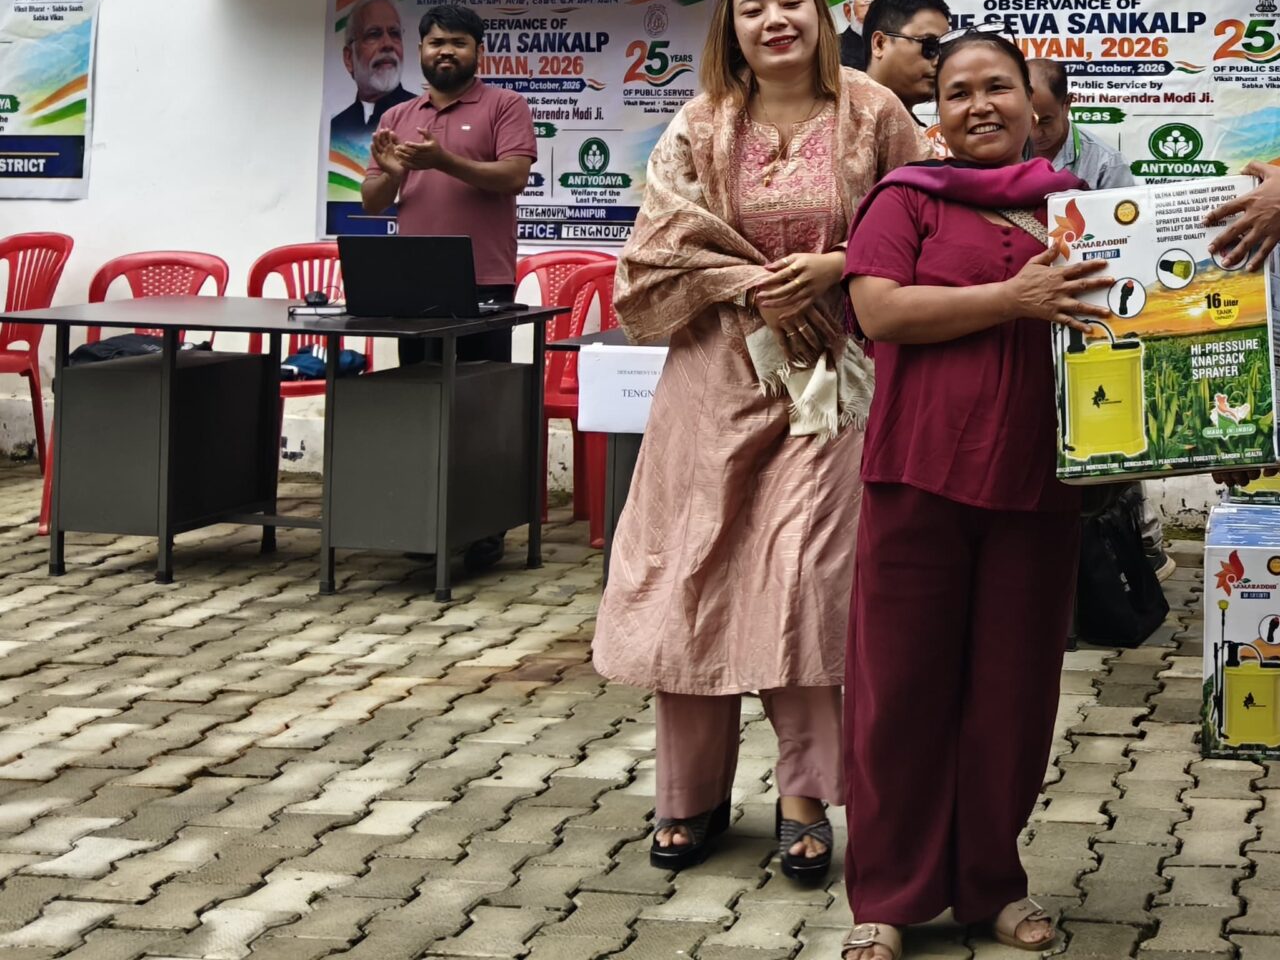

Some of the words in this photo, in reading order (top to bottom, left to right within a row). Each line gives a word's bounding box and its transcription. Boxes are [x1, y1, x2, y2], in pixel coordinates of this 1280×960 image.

[483, 18, 547, 30] SERVANCE
[550, 18, 568, 30] OF
[1067, 11, 1206, 34] SANKALP
[516, 31, 610, 53] SANKALP
[1213, 19, 1276, 61] 25
[1101, 36, 1168, 58] 2026
[538, 55, 584, 75] 2026
[623, 40, 670, 84] 25
[670, 54, 693, 63] YEARS
[1087, 63, 1135, 74] October,
[1137, 63, 1165, 73] 2026
[1213, 65, 1228, 73] OF
[1229, 65, 1266, 73] PUBLIC
[505, 81, 514, 90] to
[530, 81, 561, 92] October,
[562, 81, 581, 90] 2026
[1071, 80, 1104, 89] Public
[1107, 80, 1147, 89] Service
[1150, 80, 1163, 90] by
[623, 89, 632, 97] OF
[634, 89, 662, 97] PUBLIC
[663, 89, 695, 97] SERVICE
[1070, 92, 1095, 103] Shri
[1099, 92, 1160, 103] Narendra
[1164, 92, 1195, 103] Modi
[1198, 92, 1214, 103] Ji.
[541, 97, 567, 105] Service
[569, 97, 578, 106] by
[532, 107, 570, 121] Narendra
[572, 107, 592, 121] Modi
[595, 107, 604, 121] Ji.
[1140, 163, 1217, 174] ANTYODAYA
[568, 176, 623, 186] ANTYODAYA
[571, 189, 598, 197] Welfare
[599, 189, 608, 197] of
[608, 189, 621, 197] the
[592, 197, 617, 205] Person
[567, 208, 606, 219] MANIPUR
[517, 224, 558, 240] FFICE,
[564, 225, 632, 238] TENGNOUPA
[1184, 232, 1206, 241] QUALITY
[1205, 293, 1222, 309] 16
[1190, 338, 1259, 355] HI-PRESSURE
[1191, 352, 1246, 368] KNAPSACK
[1192, 365, 1239, 380] SPRAYER
[622, 388, 655, 398] TENGN
